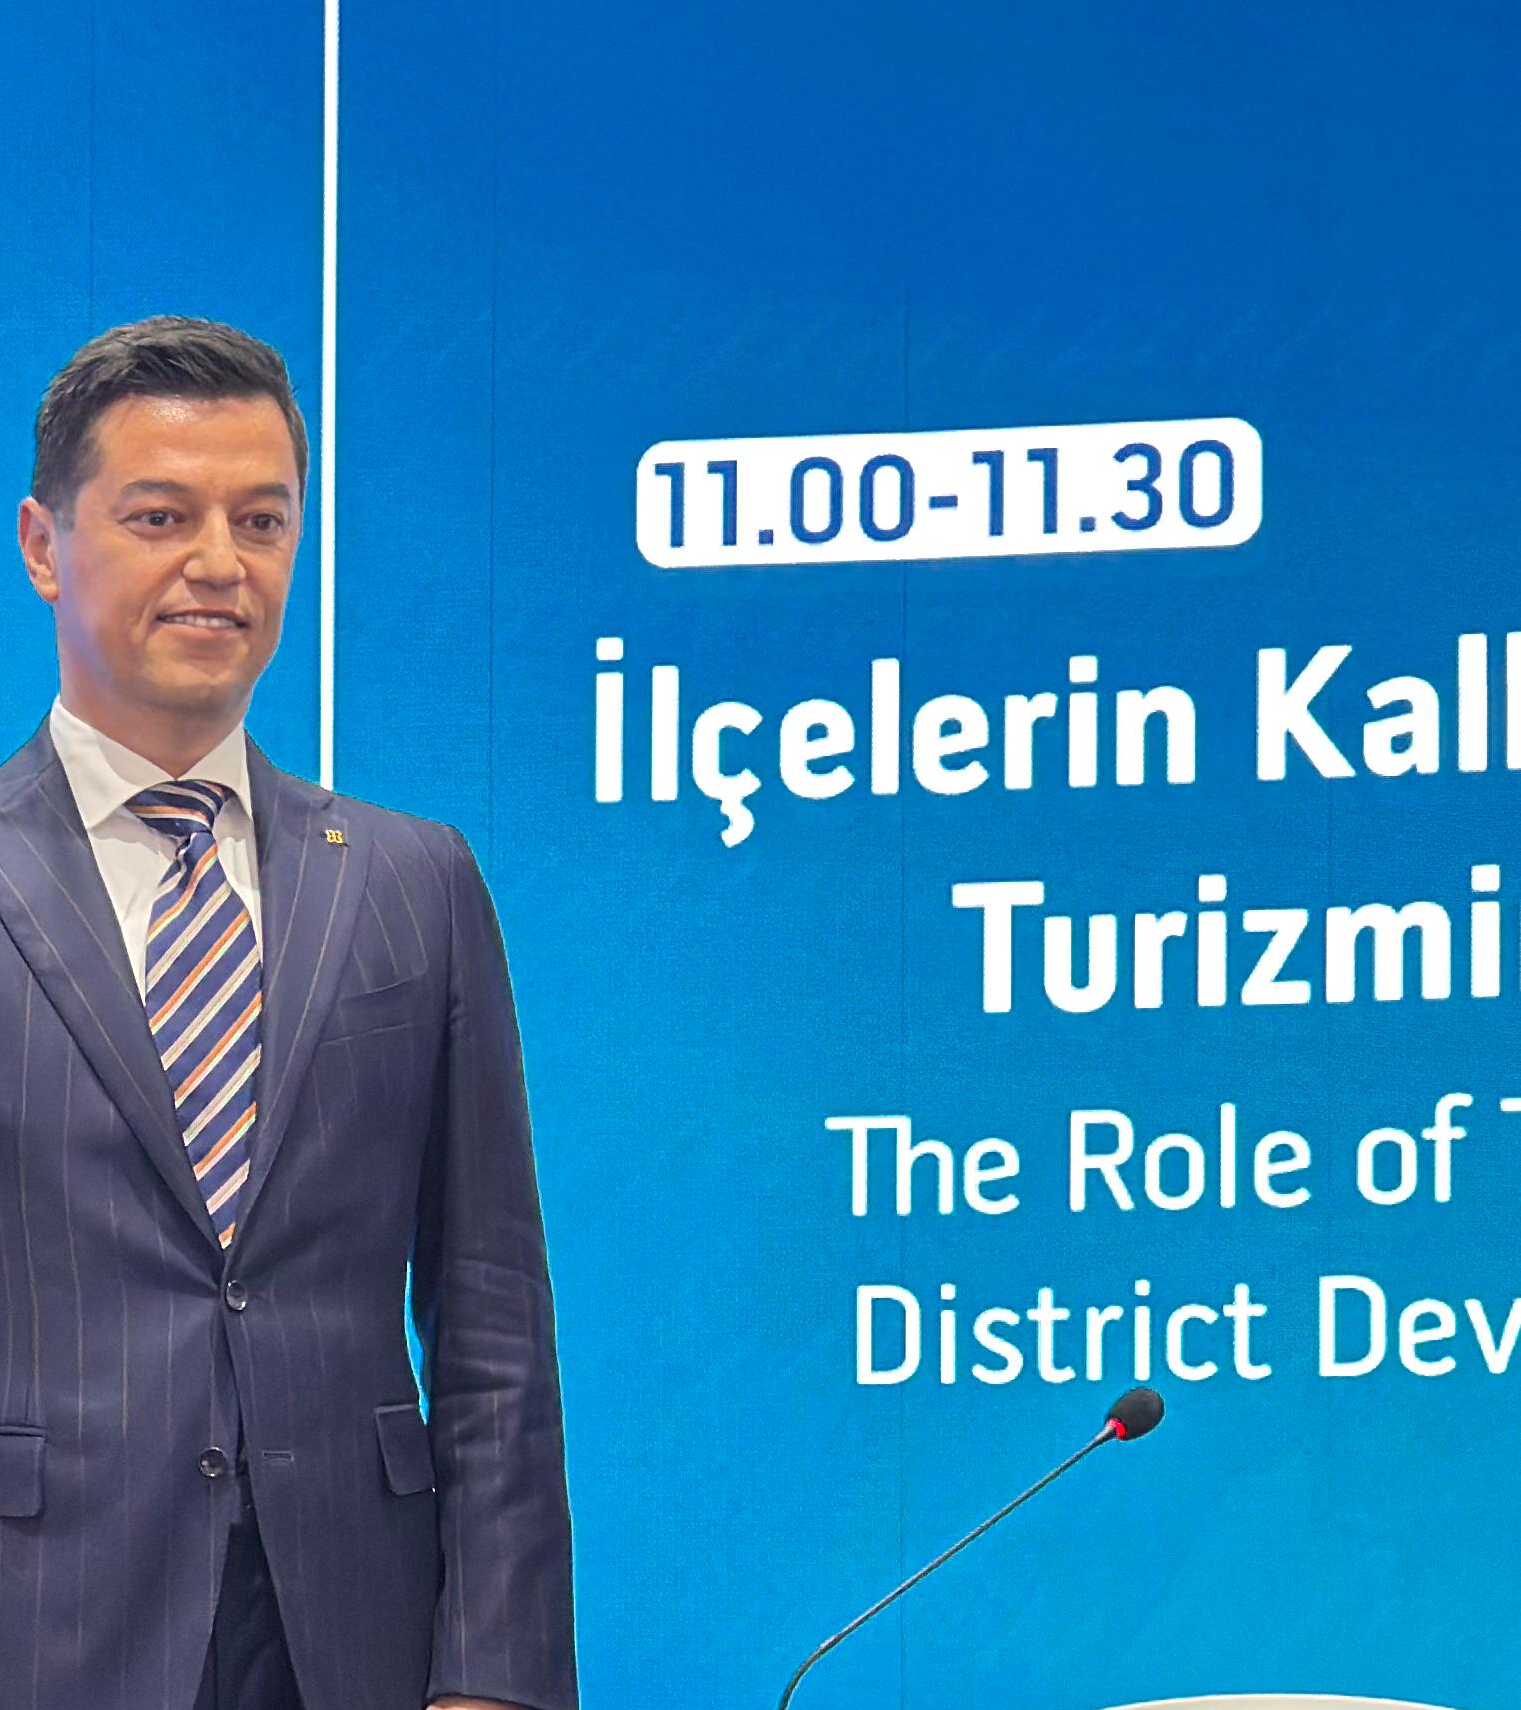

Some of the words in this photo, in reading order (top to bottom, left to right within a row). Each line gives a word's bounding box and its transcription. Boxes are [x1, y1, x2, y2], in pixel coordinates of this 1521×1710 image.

[654, 438, 1235, 549] 11.00-11.30
[595, 637, 1196, 848] İlçelerin
[952, 864, 1521, 1013] Turizmi
[824, 1115, 1020, 1217] The
[1069, 1102, 1311, 1213] Role
[1357, 1092, 1473, 1206] of
[856, 1279, 1272, 1385] District
